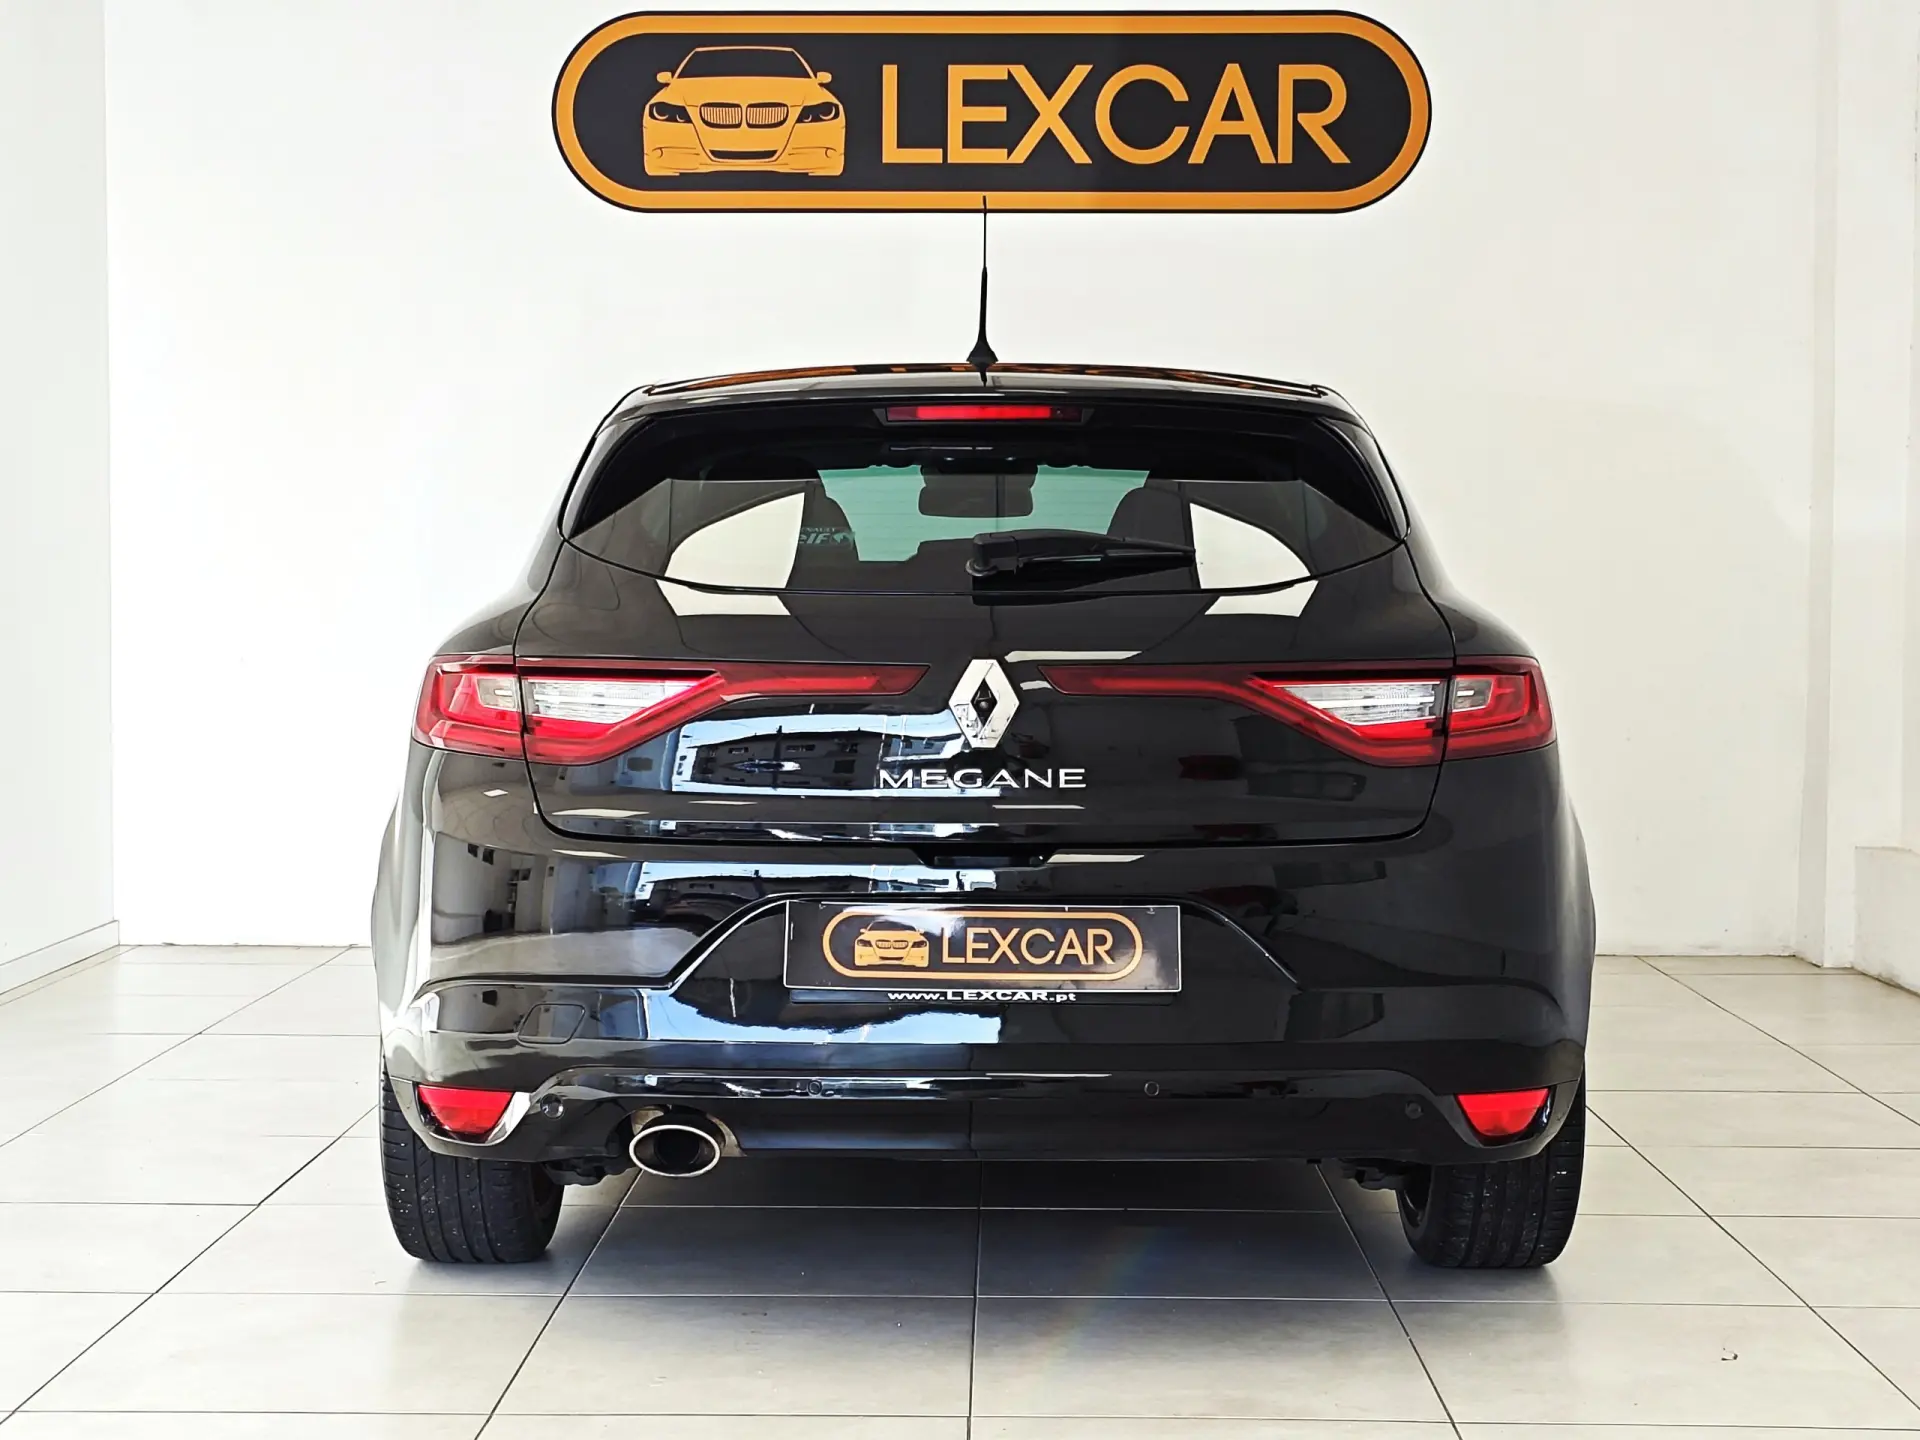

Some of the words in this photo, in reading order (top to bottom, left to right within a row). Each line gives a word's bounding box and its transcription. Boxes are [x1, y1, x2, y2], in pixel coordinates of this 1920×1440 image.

[882, 64, 1351, 165] LEXCAR
[879, 768, 1087, 789] MEGANE
[940, 927, 1115, 965] LEXCAR
[887, 990, 1077, 1003] www.LEXCAR.pt
